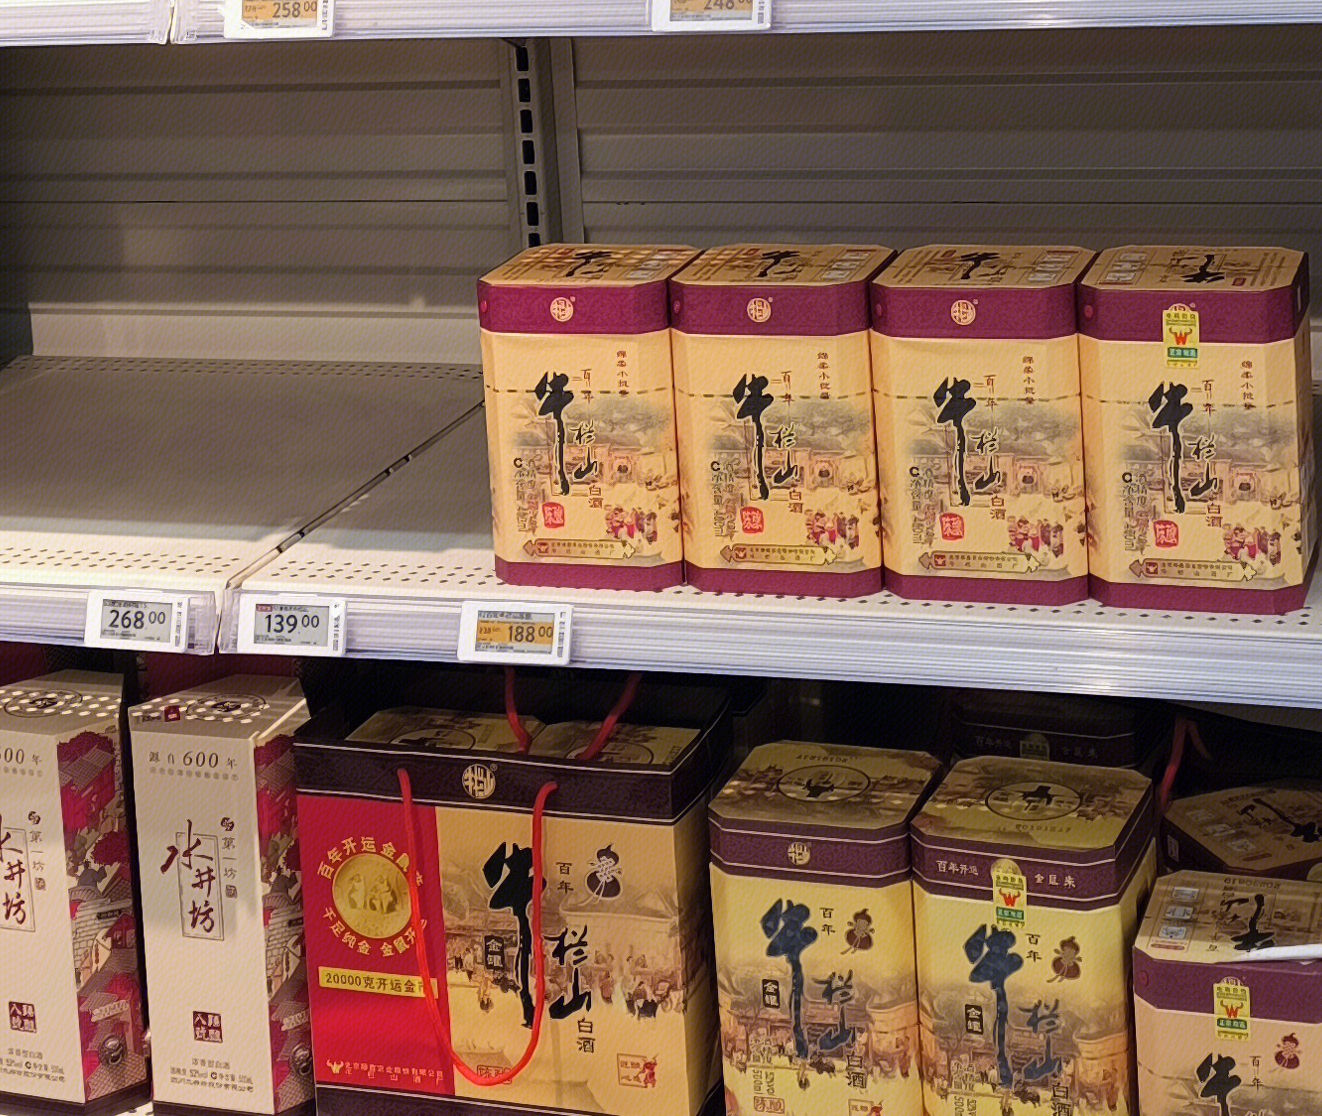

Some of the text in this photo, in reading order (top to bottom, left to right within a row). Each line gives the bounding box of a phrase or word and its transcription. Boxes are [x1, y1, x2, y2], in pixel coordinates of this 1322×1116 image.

[160, 819, 216, 934] 水井坊
[555, 862, 574, 895] 百年
[820, 907, 836, 936] 百年
[1026, 934, 1042, 963] 百年
[325, 972, 425, 995] 20000克开运金
[577, 1019, 596, 1054] 白酒
